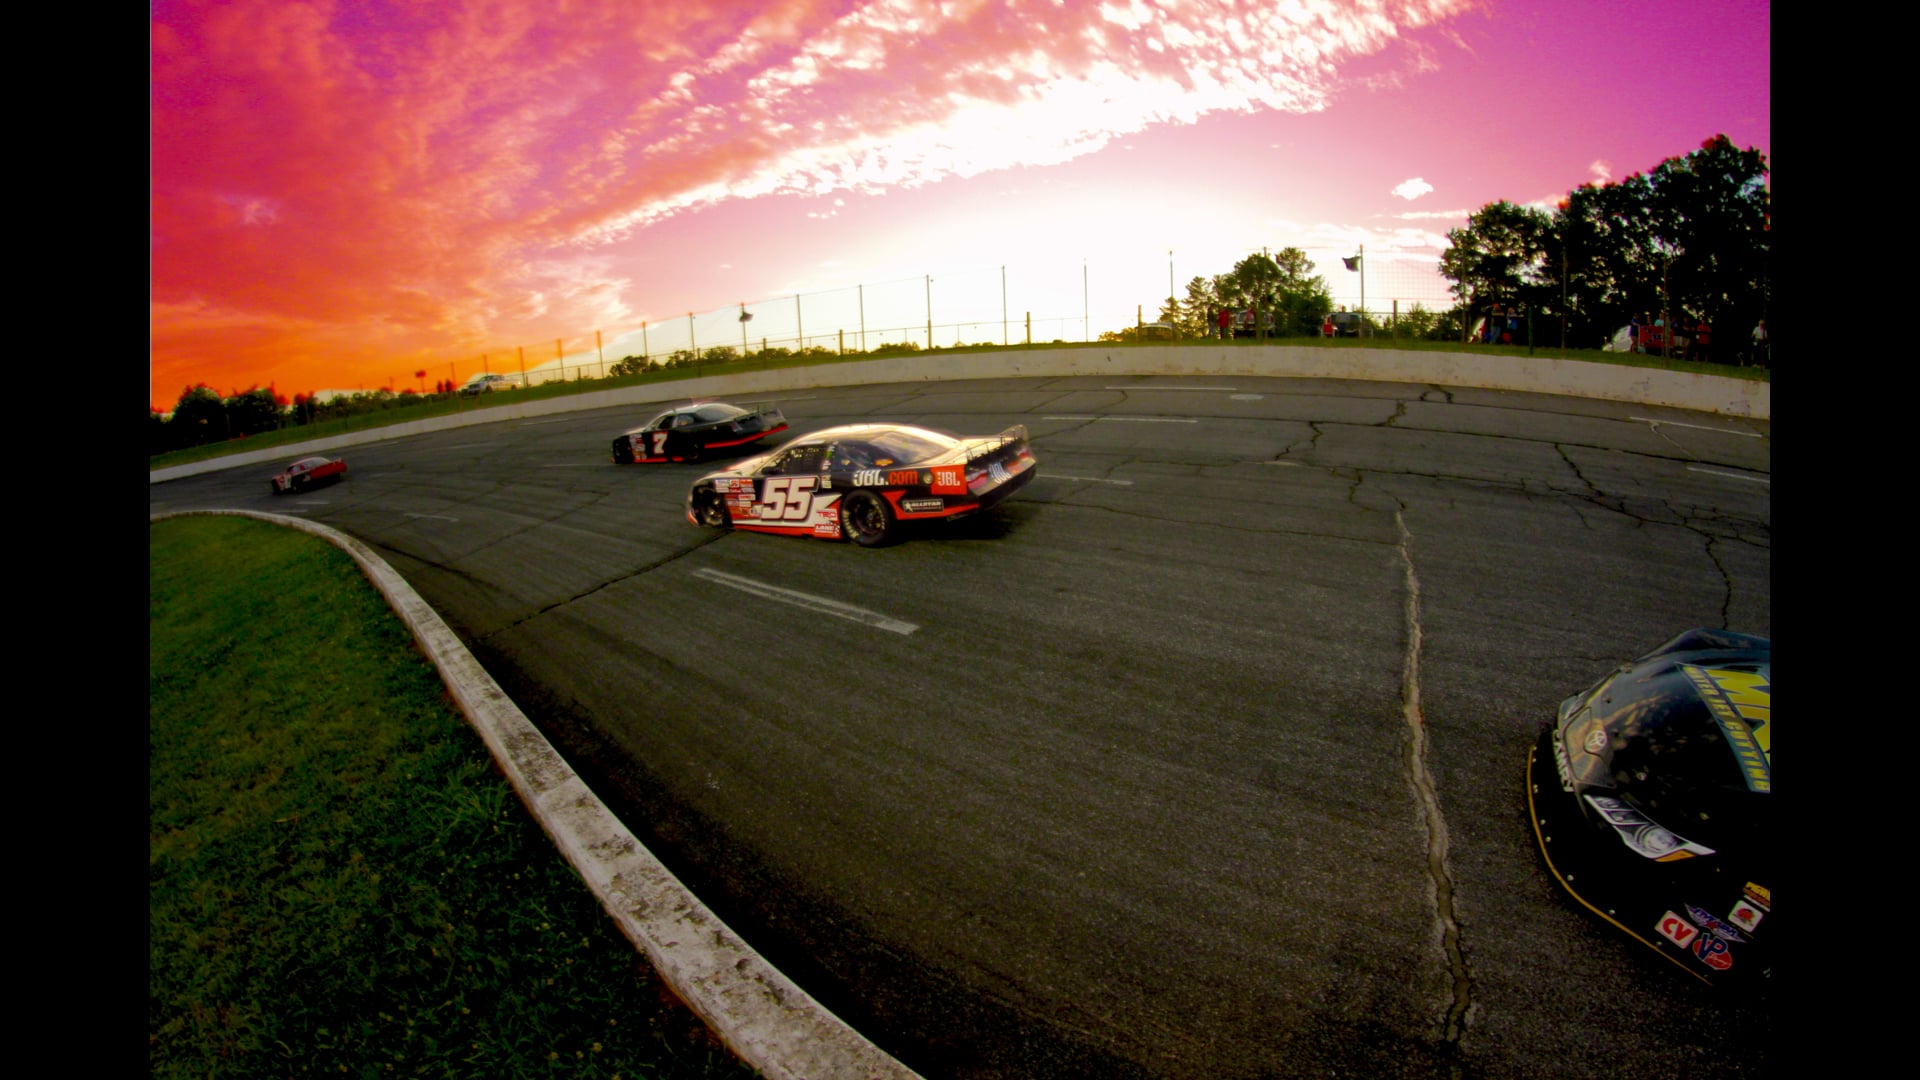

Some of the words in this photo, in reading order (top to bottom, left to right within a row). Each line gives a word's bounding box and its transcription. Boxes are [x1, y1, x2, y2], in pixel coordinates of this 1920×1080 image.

[652, 430, 668, 455] 7
[853, 469, 919, 487] JBL.com
[937, 471, 961, 486] JBL
[761, 477, 817, 520] 55
[1662, 917, 1693, 941] CV
[1697, 932, 1729, 961] VP
